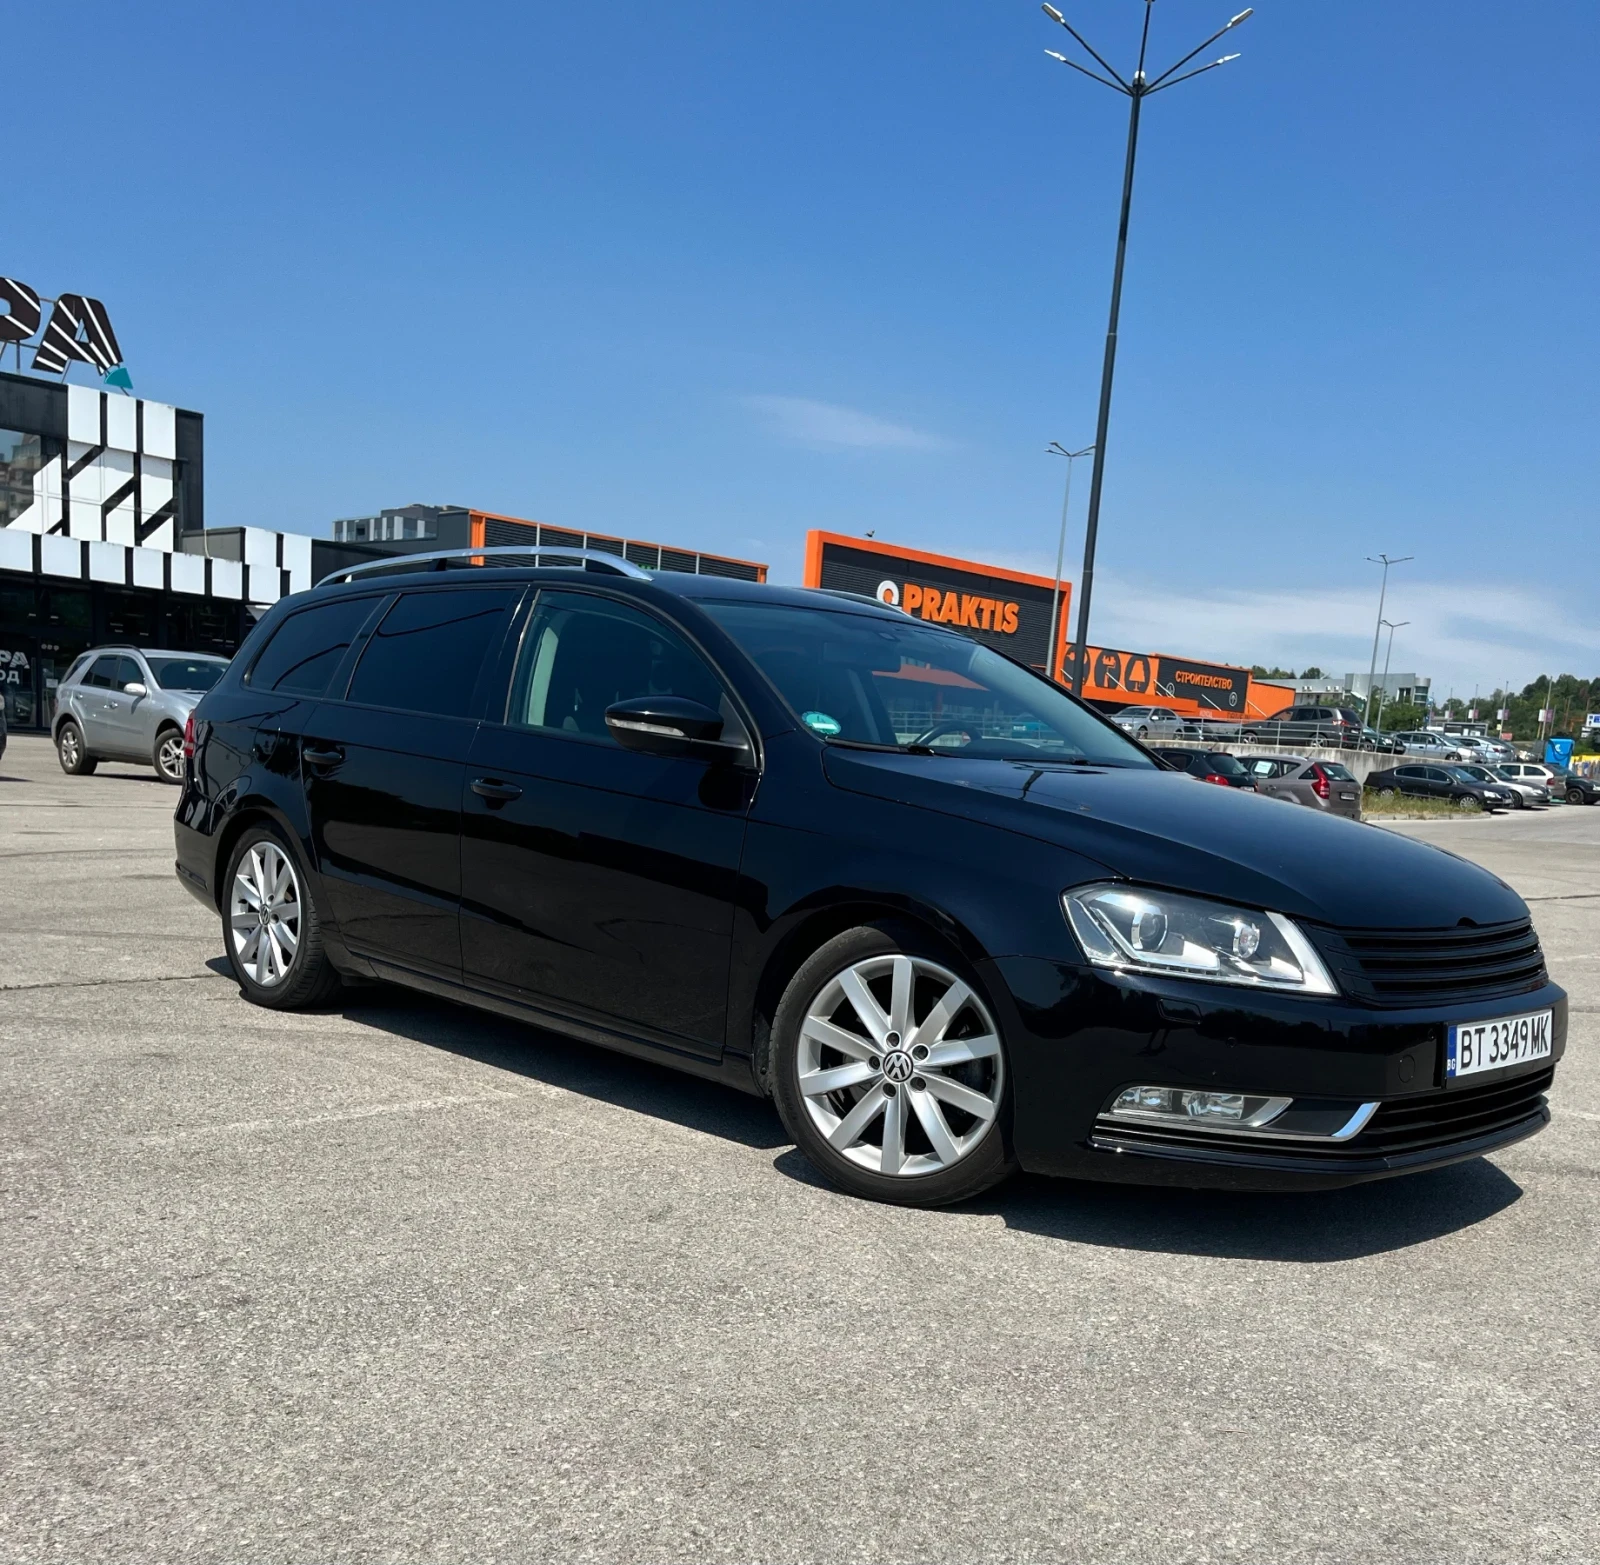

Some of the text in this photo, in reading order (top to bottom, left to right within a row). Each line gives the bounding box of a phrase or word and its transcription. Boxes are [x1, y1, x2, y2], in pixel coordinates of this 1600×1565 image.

[902, 583, 1020, 634] PRAKTIS
[1175, 670, 1233, 690] СТРОИТЕЛСТВО
[1460, 1015, 1549, 1070] BT 3349 MK
[1447, 1059, 1456, 1071] BG
